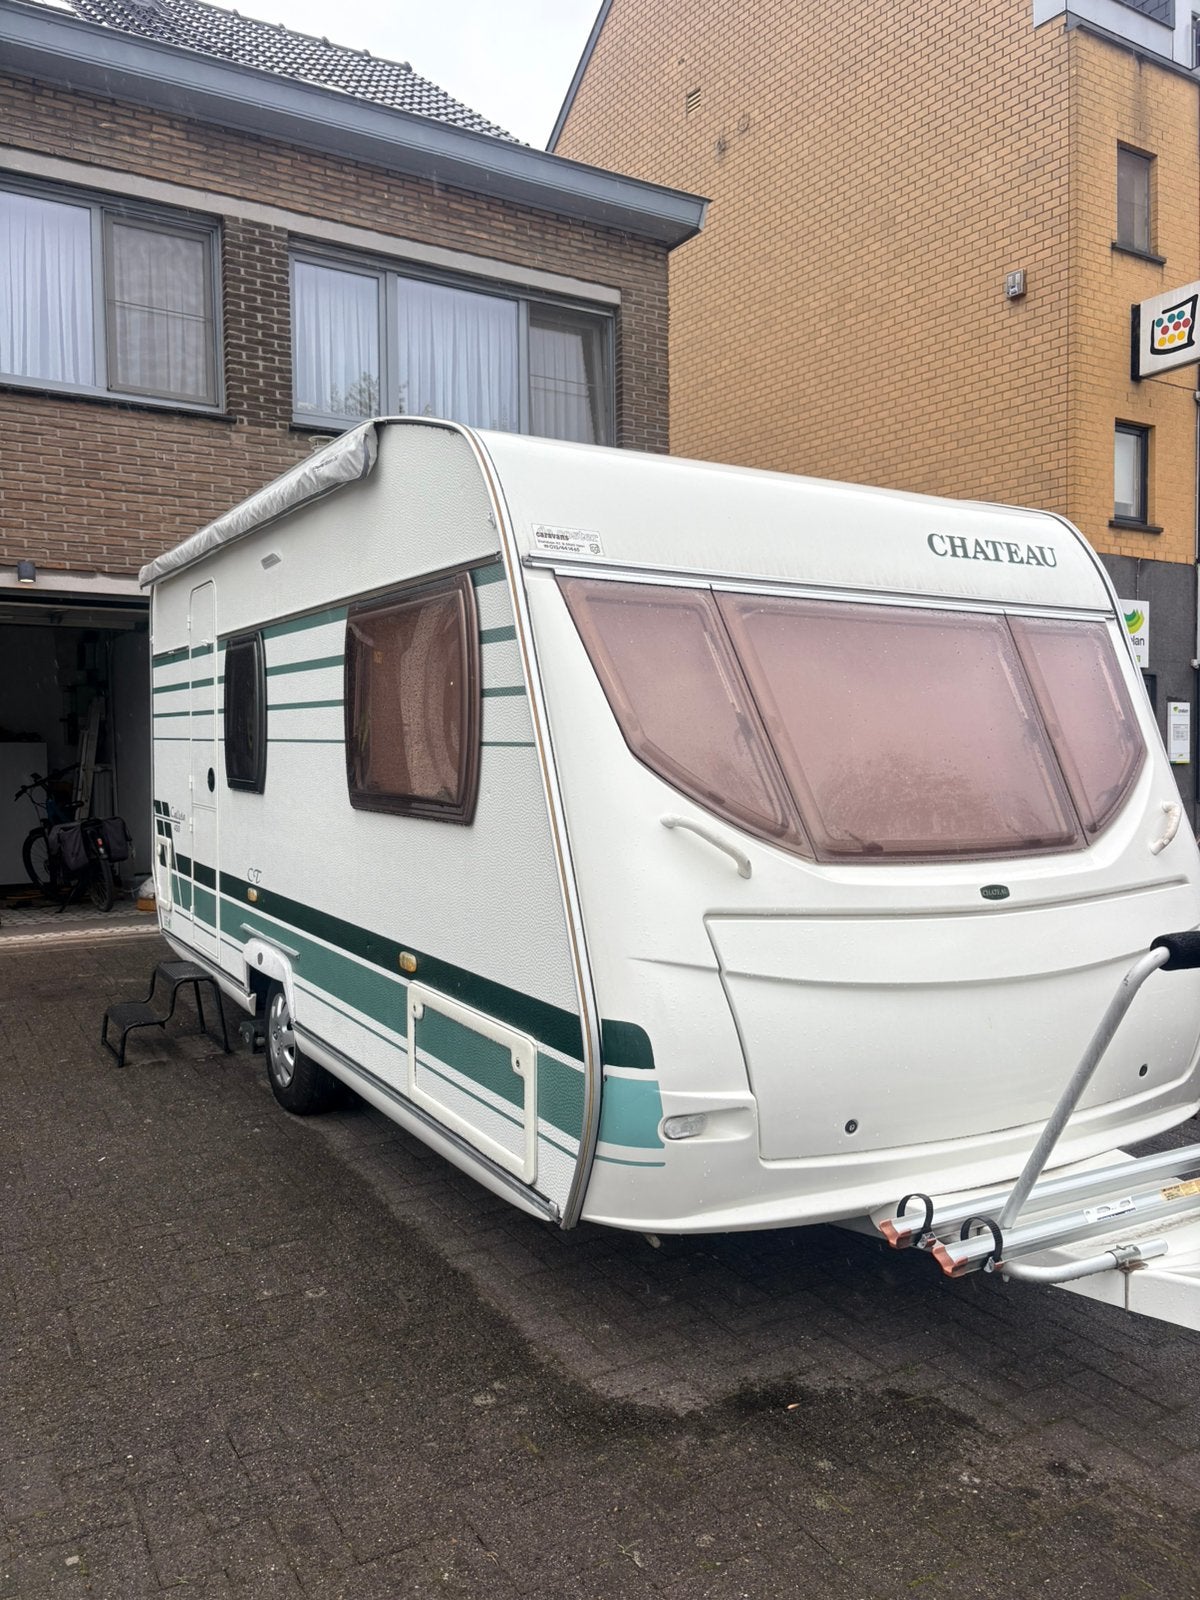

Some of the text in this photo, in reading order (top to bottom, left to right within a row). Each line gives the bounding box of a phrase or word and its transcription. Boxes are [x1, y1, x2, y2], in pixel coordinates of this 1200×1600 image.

[535, 531, 570, 541] caravans
[927, 533, 1057, 568] CHATEAU
[1131, 636, 1145, 646] lan
